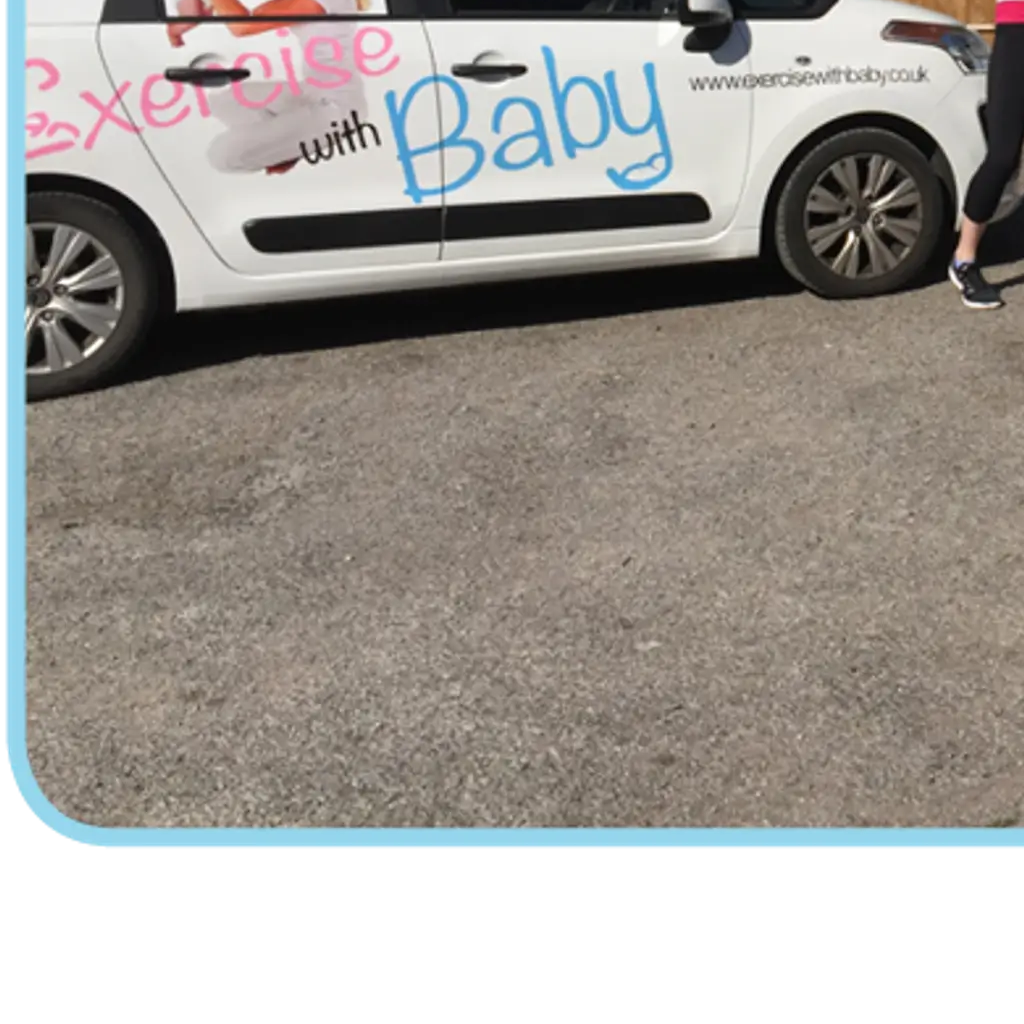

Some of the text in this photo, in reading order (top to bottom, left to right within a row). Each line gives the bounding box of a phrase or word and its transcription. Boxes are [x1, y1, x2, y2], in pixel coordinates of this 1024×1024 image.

[689, 65, 930, 91] www.exercisewithbaby.co.uk
[300, 45, 674, 204] with Baby
